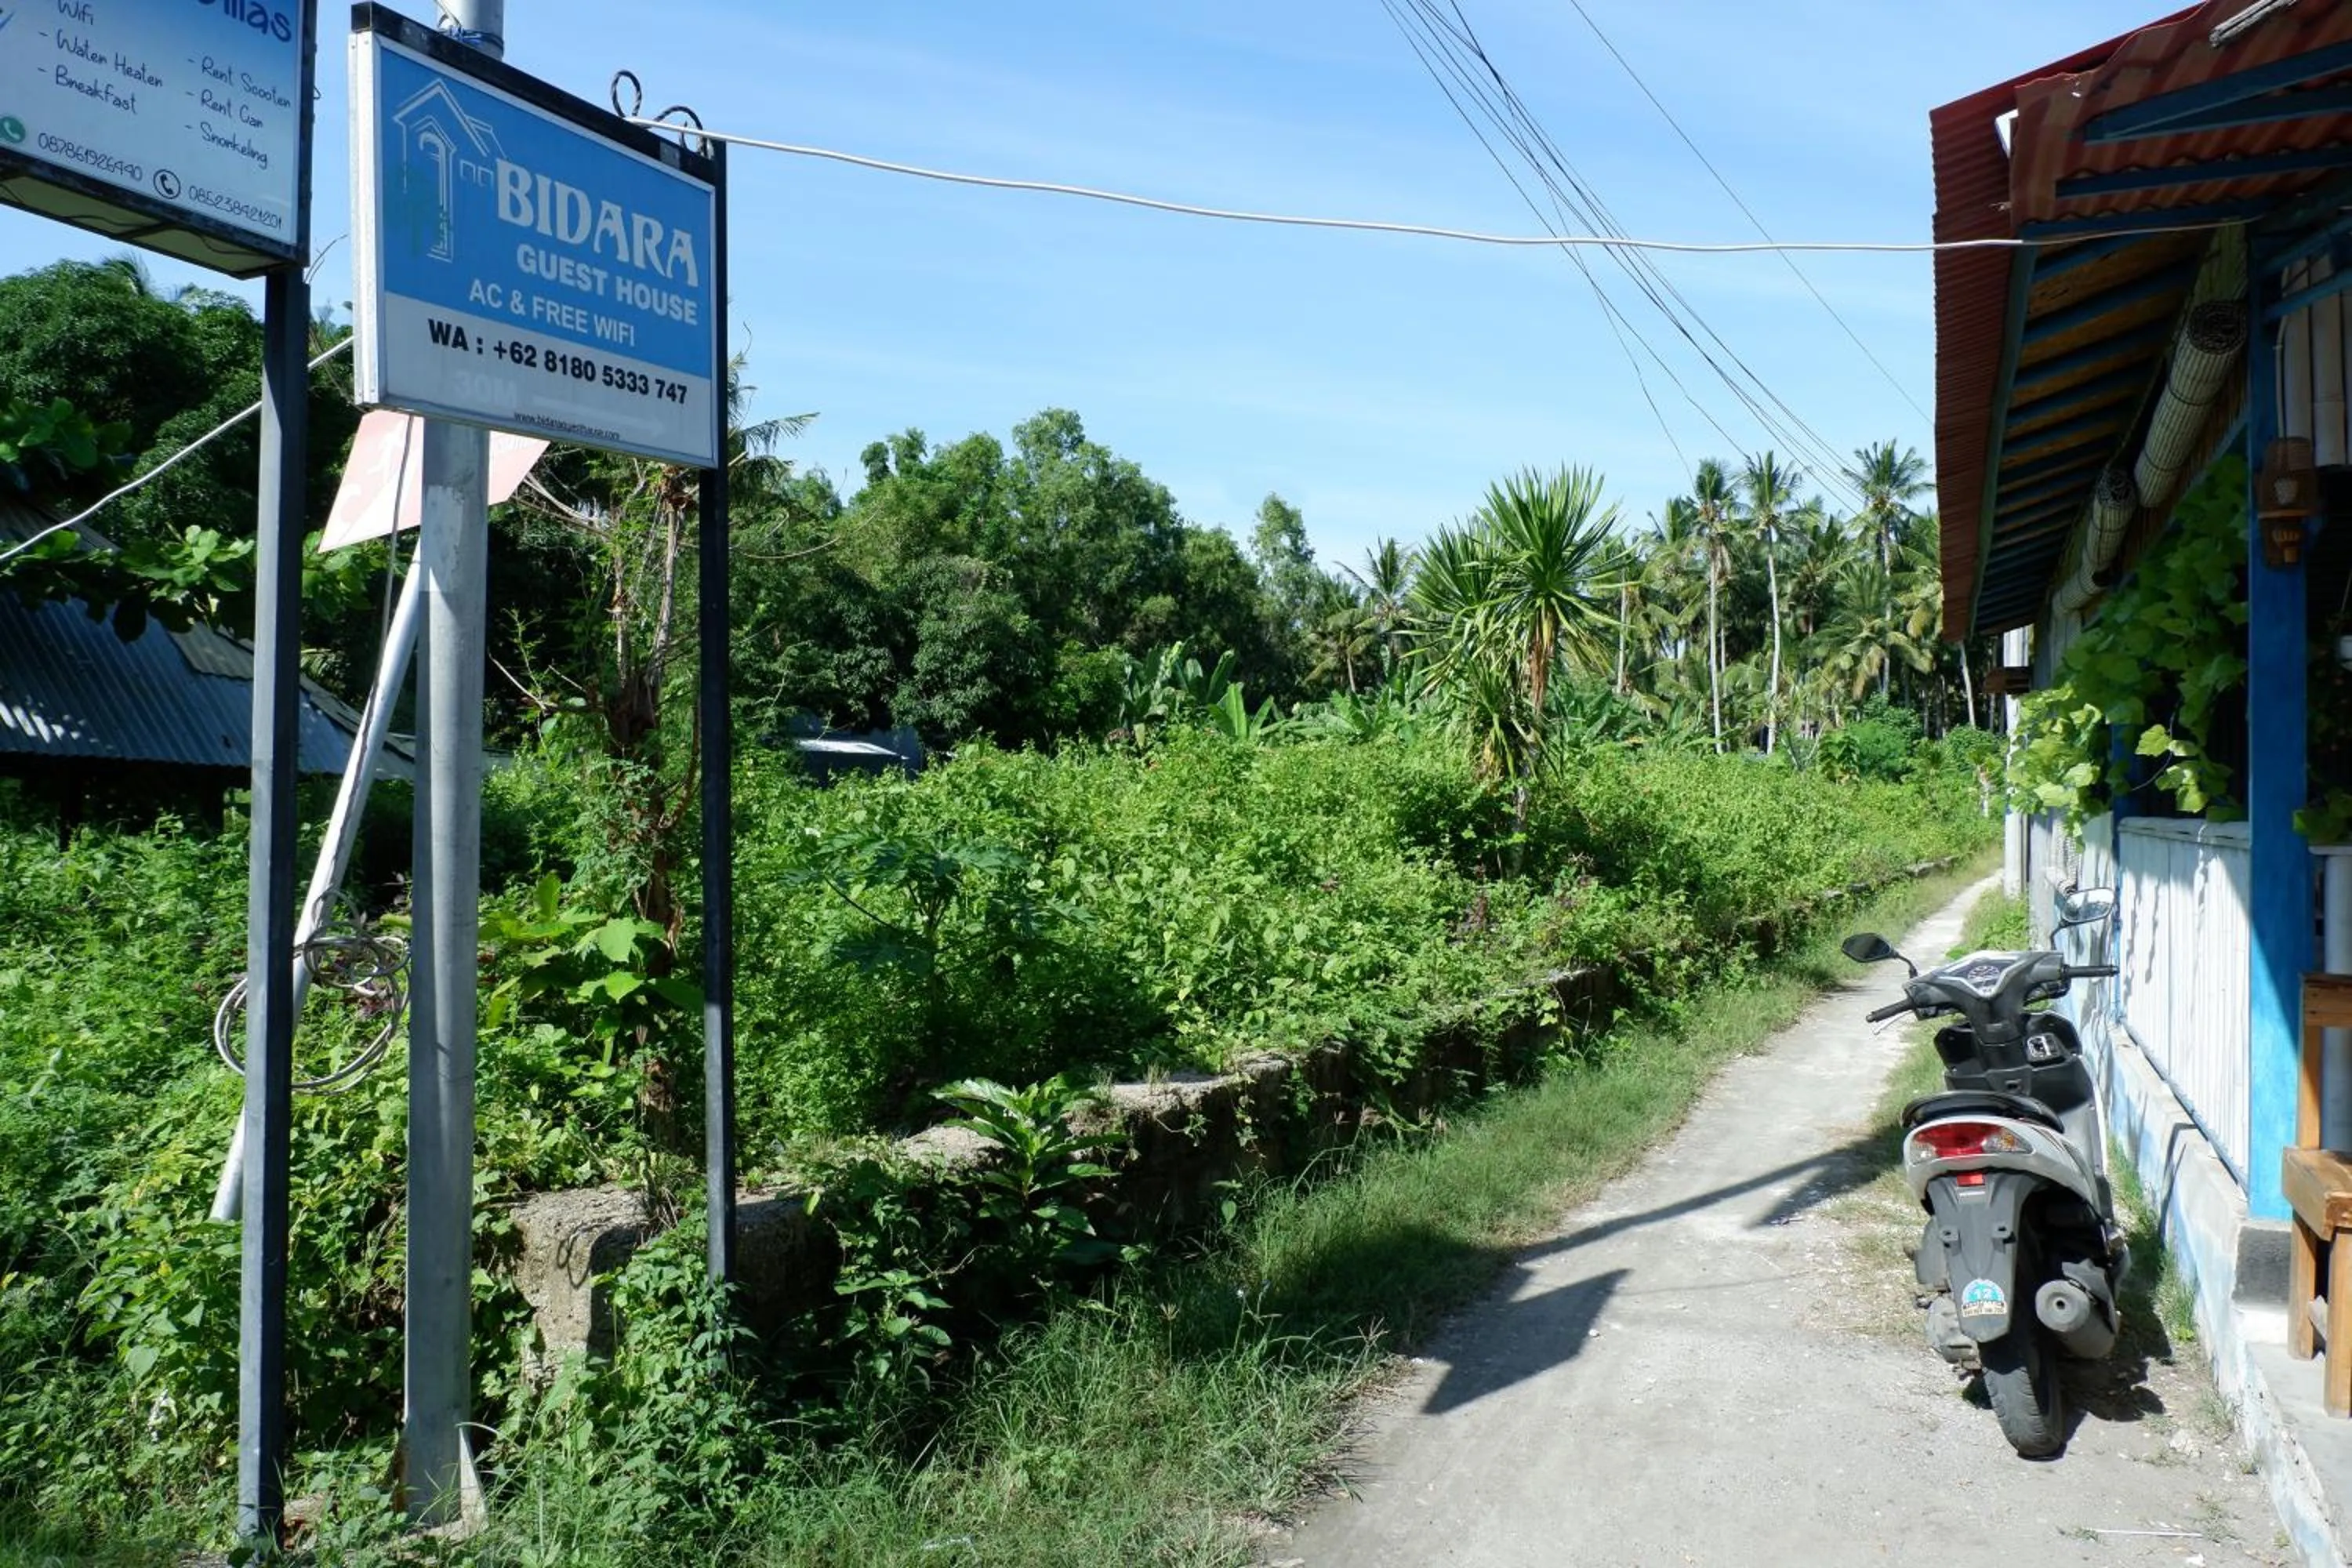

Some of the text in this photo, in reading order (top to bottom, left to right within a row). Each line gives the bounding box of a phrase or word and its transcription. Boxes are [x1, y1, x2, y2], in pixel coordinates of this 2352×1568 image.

[57, 0, 93, 25] Wifi
[56, 28, 107, 64] Water
[114, 53, 163, 87] Heater
[201, 56, 234, 86] Rent
[241, 72, 291, 108] Scooter
[56, 64, 136, 114] Breakfast
[201, 89, 233, 118] Rent
[239, 104, 264, 129] Car
[200, 122, 268, 170] Snorkeling
[495, 158, 699, 287] BIDARA
[517, 243, 698, 326] GUEST HOUSE
[469, 278, 635, 347] AC & FREE WIFI
[428, 318, 469, 351] WA
[494, 340, 537, 368] +62
[544, 350, 597, 382] 8180
[601, 365, 649, 395] 5333
[655, 379, 688, 405] 747
